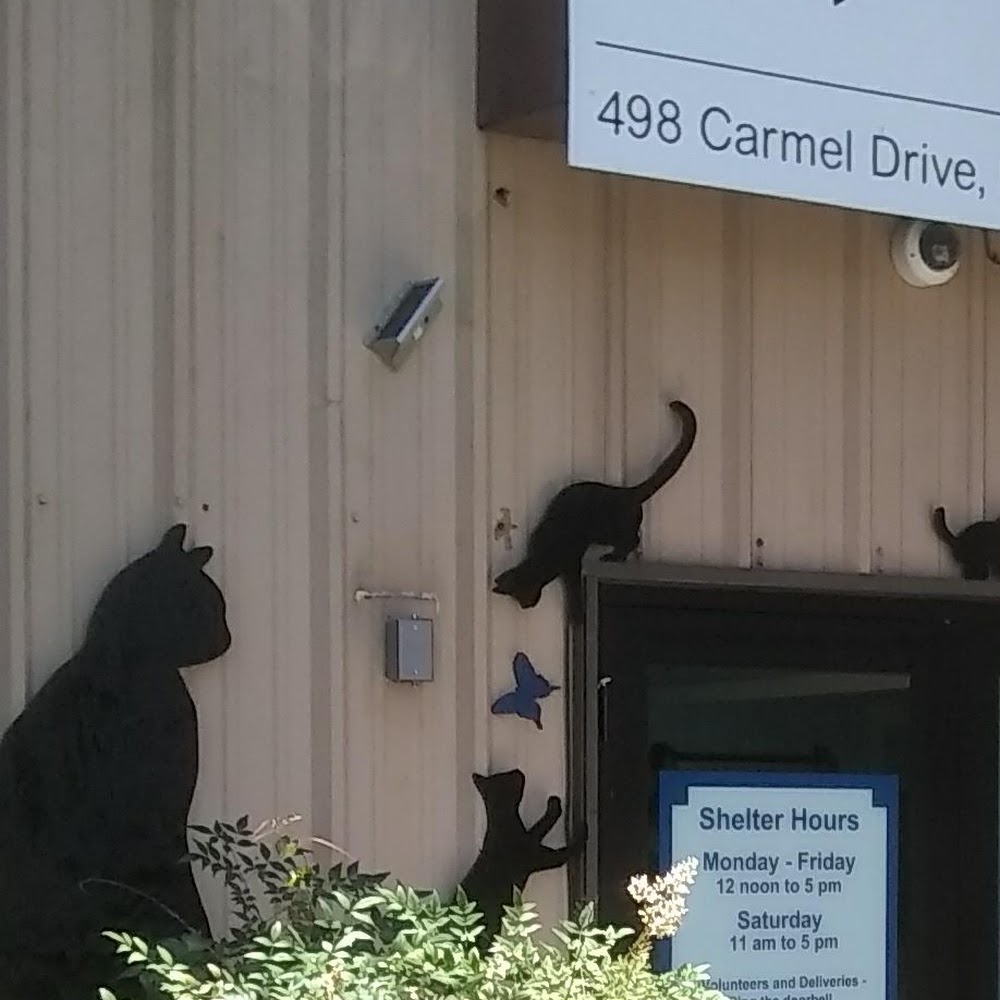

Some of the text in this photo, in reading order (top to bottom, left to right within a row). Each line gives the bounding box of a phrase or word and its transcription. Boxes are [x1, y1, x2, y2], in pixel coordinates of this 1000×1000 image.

[597, 91, 682, 144] 498
[700, 106, 852, 173] Carmel
[872, 134, 985, 199] Drive,
[699, 807, 860, 832] Shelter Hours
[703, 851, 779, 876] Monday
[798, 851, 856, 876] Friday
[716, 877, 842, 897] 12 noon to 5 pm
[737, 910, 823, 933] Saturday
[730, 934, 839, 953] 11 am to 5 pm
[773, 976, 796, 989] and
[800, 975, 859, 989] Deliveries
